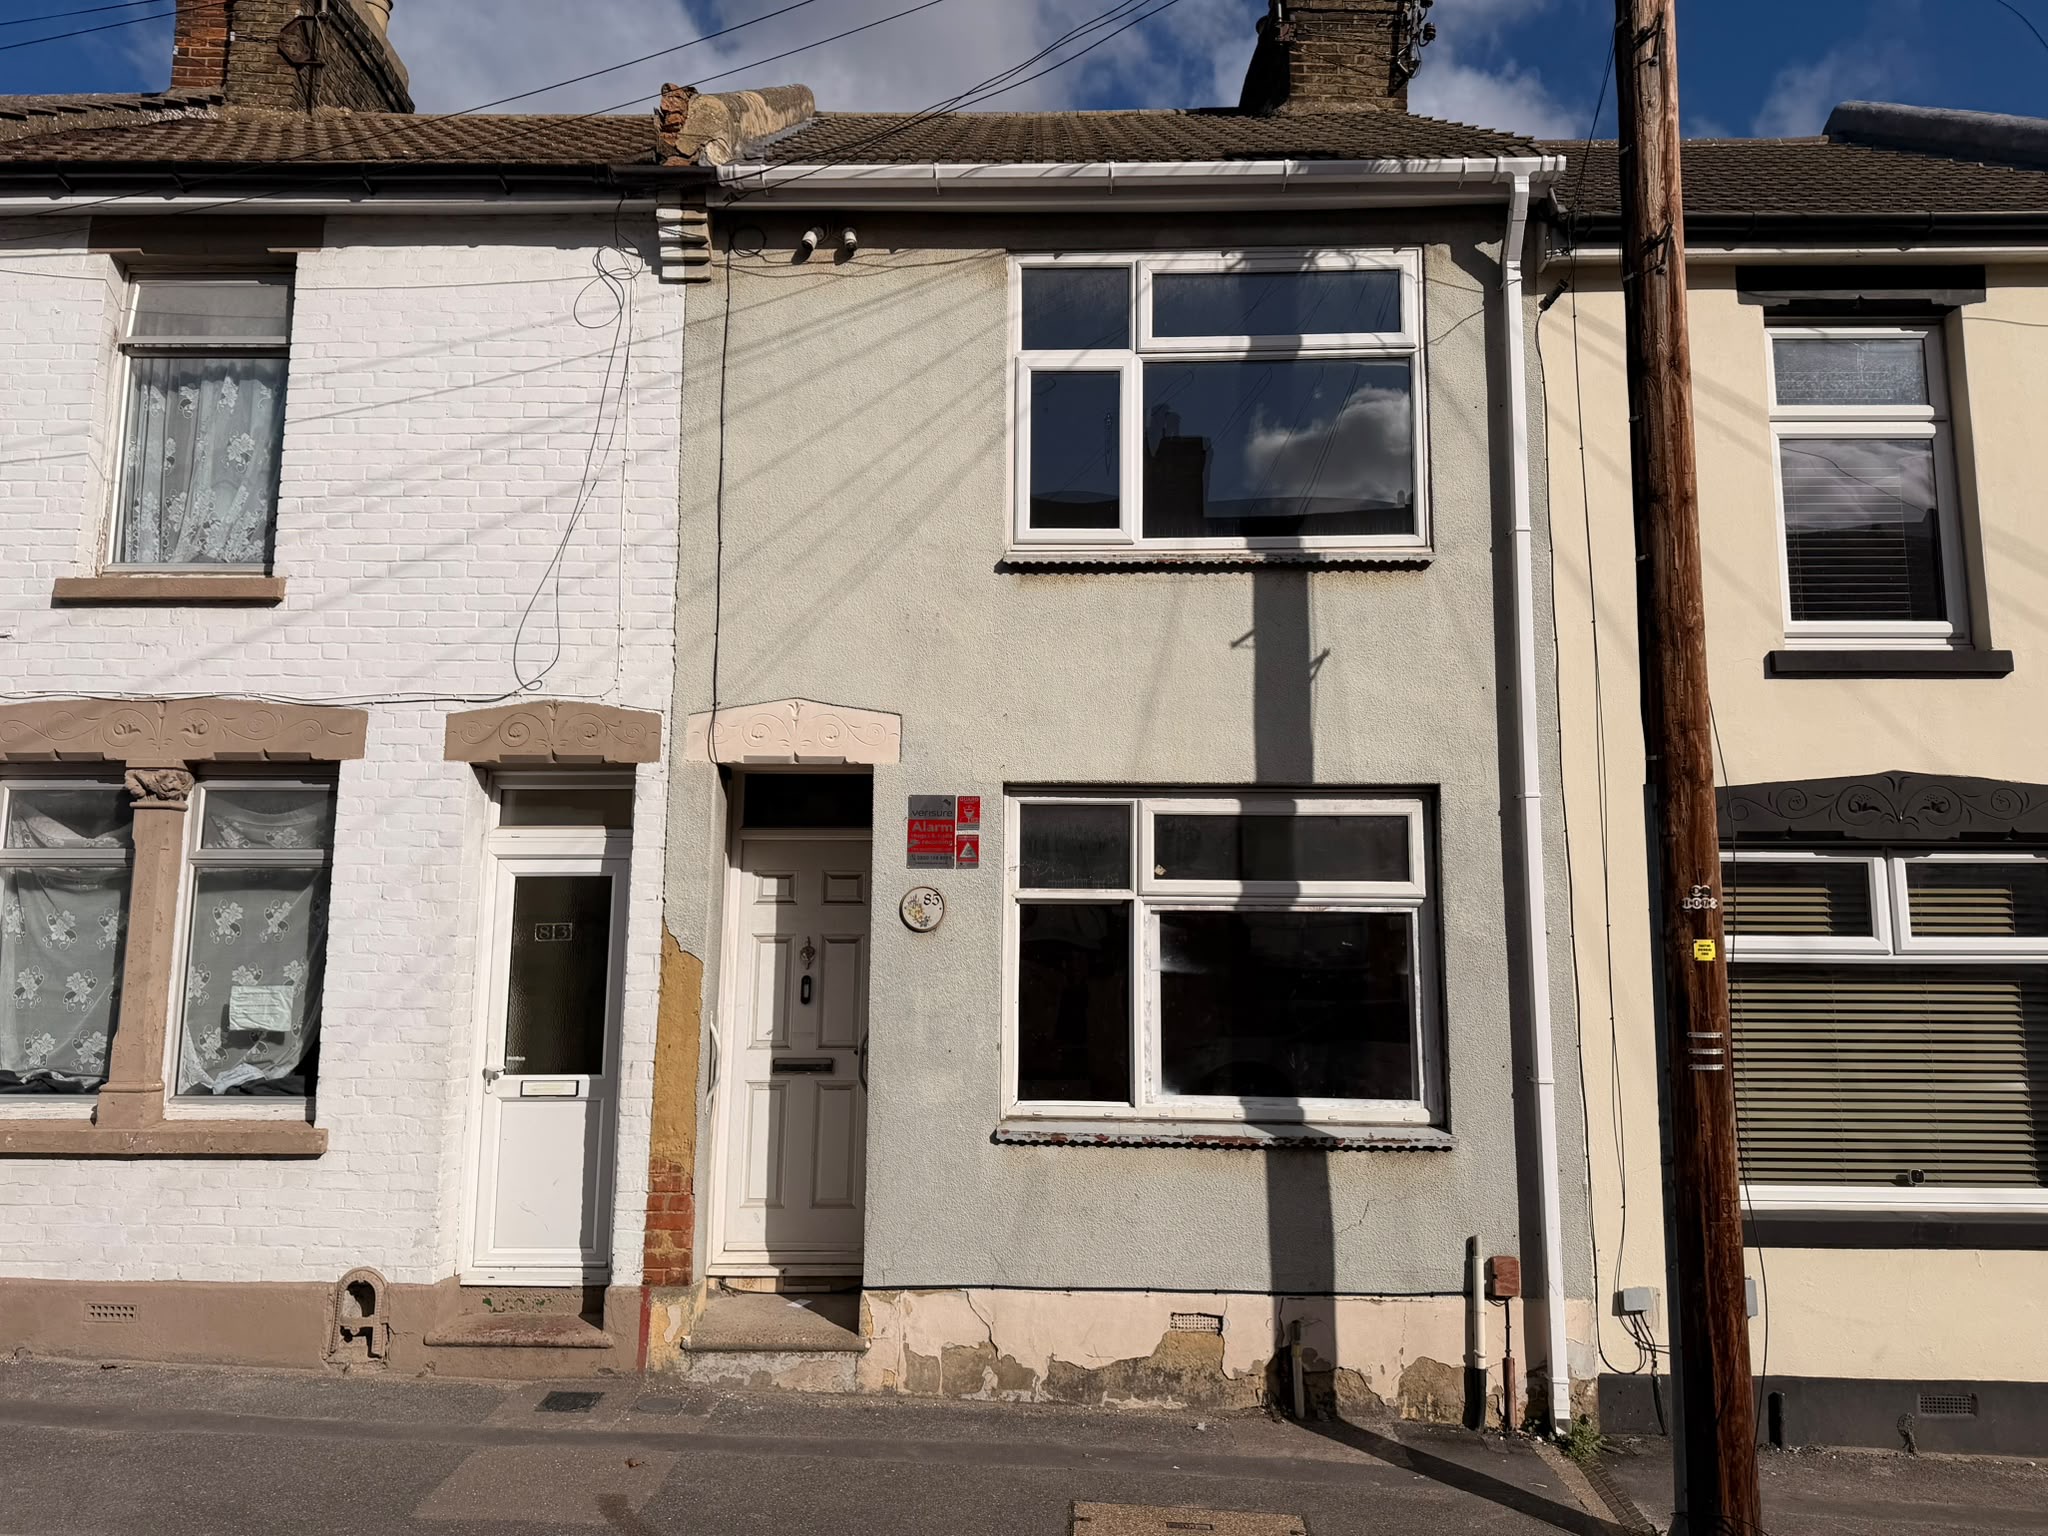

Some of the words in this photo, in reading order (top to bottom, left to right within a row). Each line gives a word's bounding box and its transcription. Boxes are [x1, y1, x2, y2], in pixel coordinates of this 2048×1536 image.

[911, 809, 953, 817] verisure
[911, 820, 954, 833] Alarm
[539, 925, 568, 939] 83
